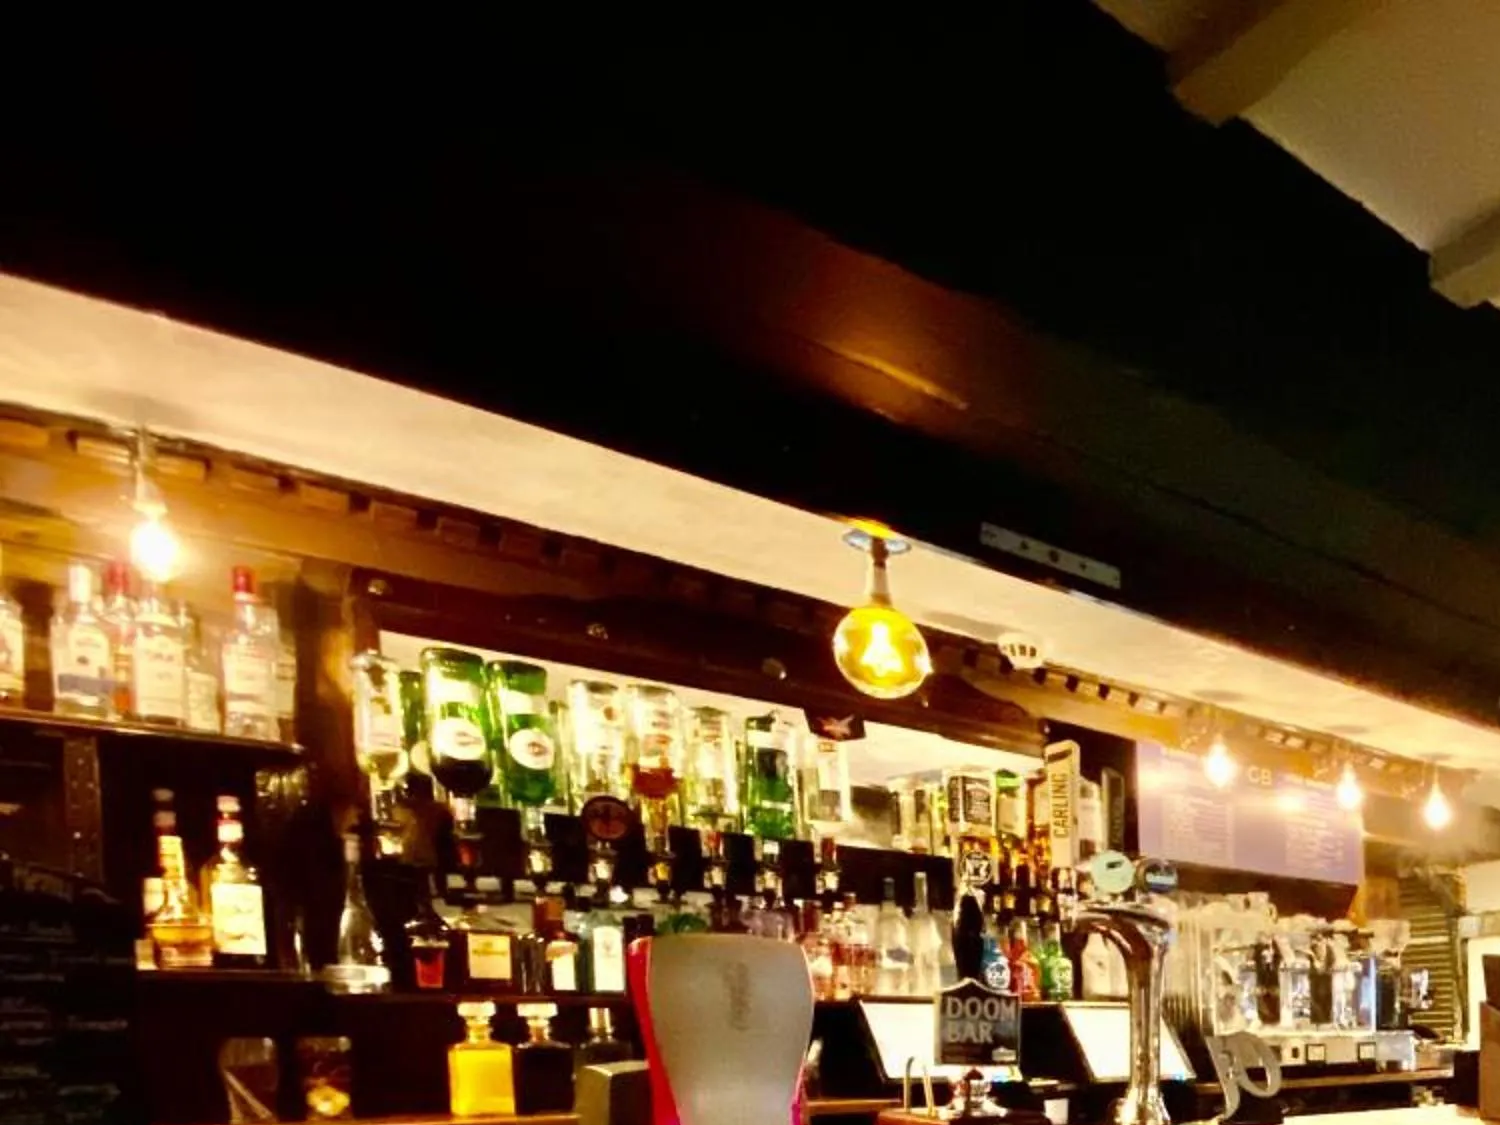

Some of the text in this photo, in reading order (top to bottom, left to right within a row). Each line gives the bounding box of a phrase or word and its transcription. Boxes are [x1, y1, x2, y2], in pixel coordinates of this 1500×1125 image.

[1051, 772, 1069, 839] CARLING
[945, 996, 1017, 1020] DOOM
[945, 1021, 994, 1043] BAR
